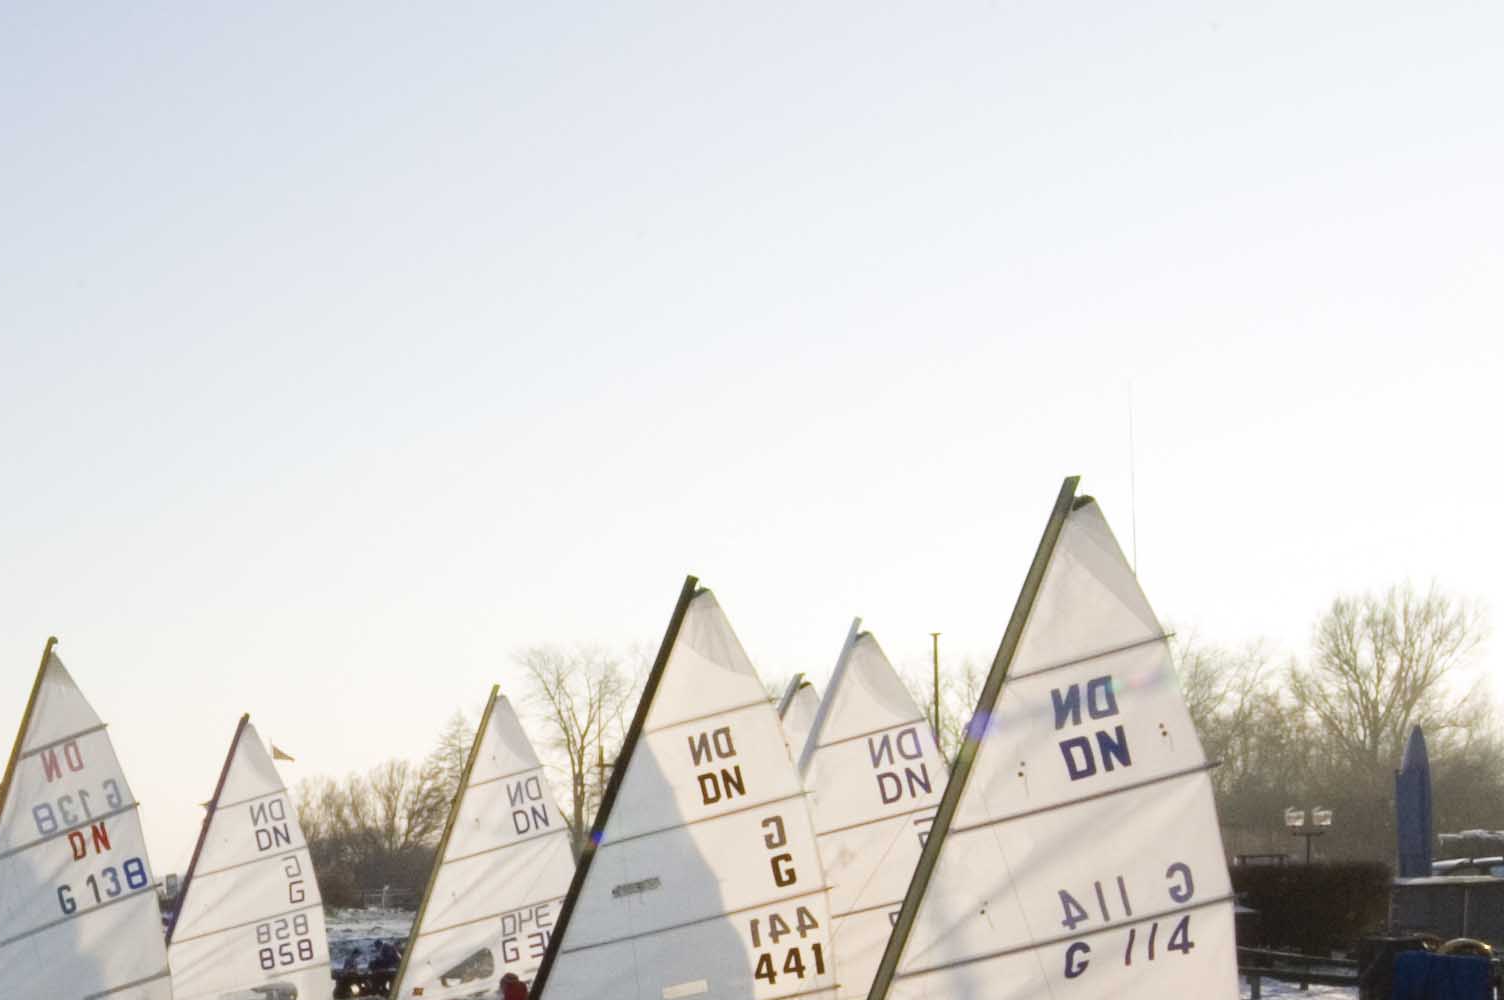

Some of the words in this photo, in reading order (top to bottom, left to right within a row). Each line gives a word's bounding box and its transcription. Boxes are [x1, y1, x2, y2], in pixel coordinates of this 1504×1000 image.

[1059, 725, 1132, 781] DN
[697, 765, 746, 805] DN
[876, 763, 932, 805] DN
[255, 824, 291, 851] DN
[512, 804, 550, 835] DN
[67, 821, 112, 861] DN
[57, 884, 77, 915] G
[86, 857, 148, 903] 138
[770, 853, 796, 888] G
[289, 880, 305, 904] G
[259, 938, 314, 970] 858
[502, 937, 520, 963] G
[754, 943, 826, 985] 441
[1064, 941, 1091, 979] G
[1125, 915, 1195, 966] 114
